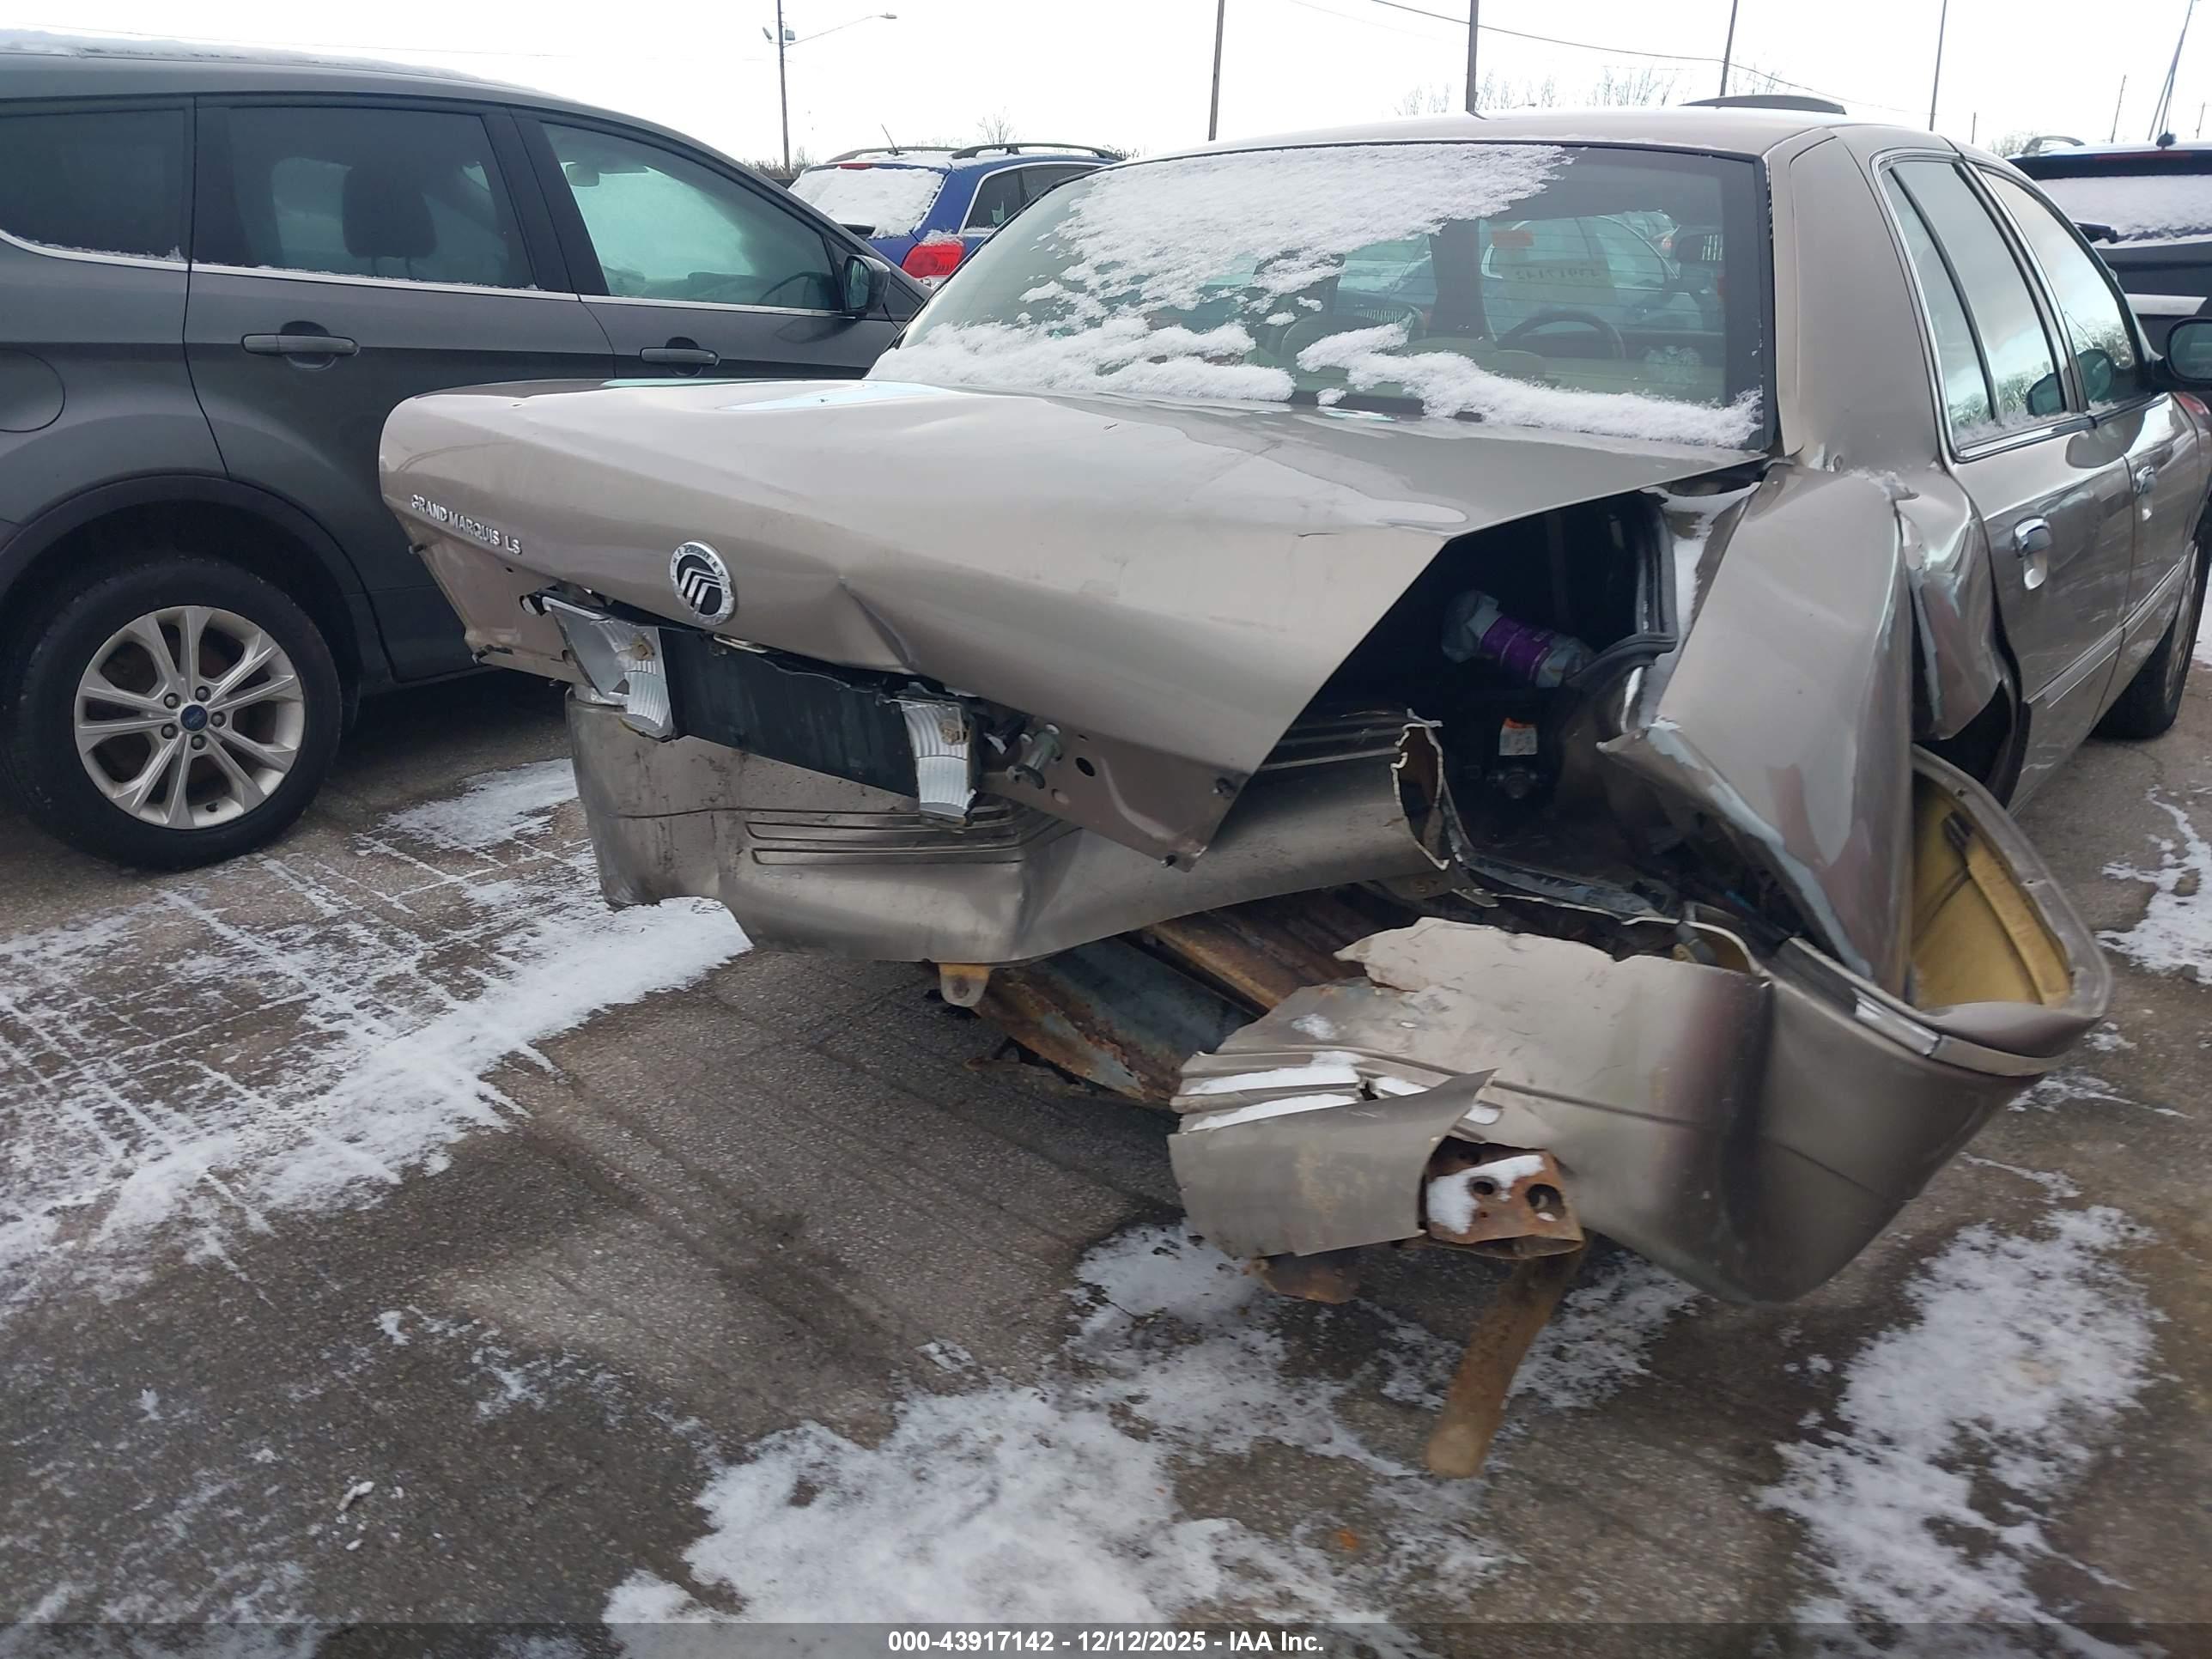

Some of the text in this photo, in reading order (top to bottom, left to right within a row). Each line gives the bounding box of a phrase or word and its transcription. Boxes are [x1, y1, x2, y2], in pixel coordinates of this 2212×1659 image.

[411, 494, 522, 555] GRAND MARQUIS LS
